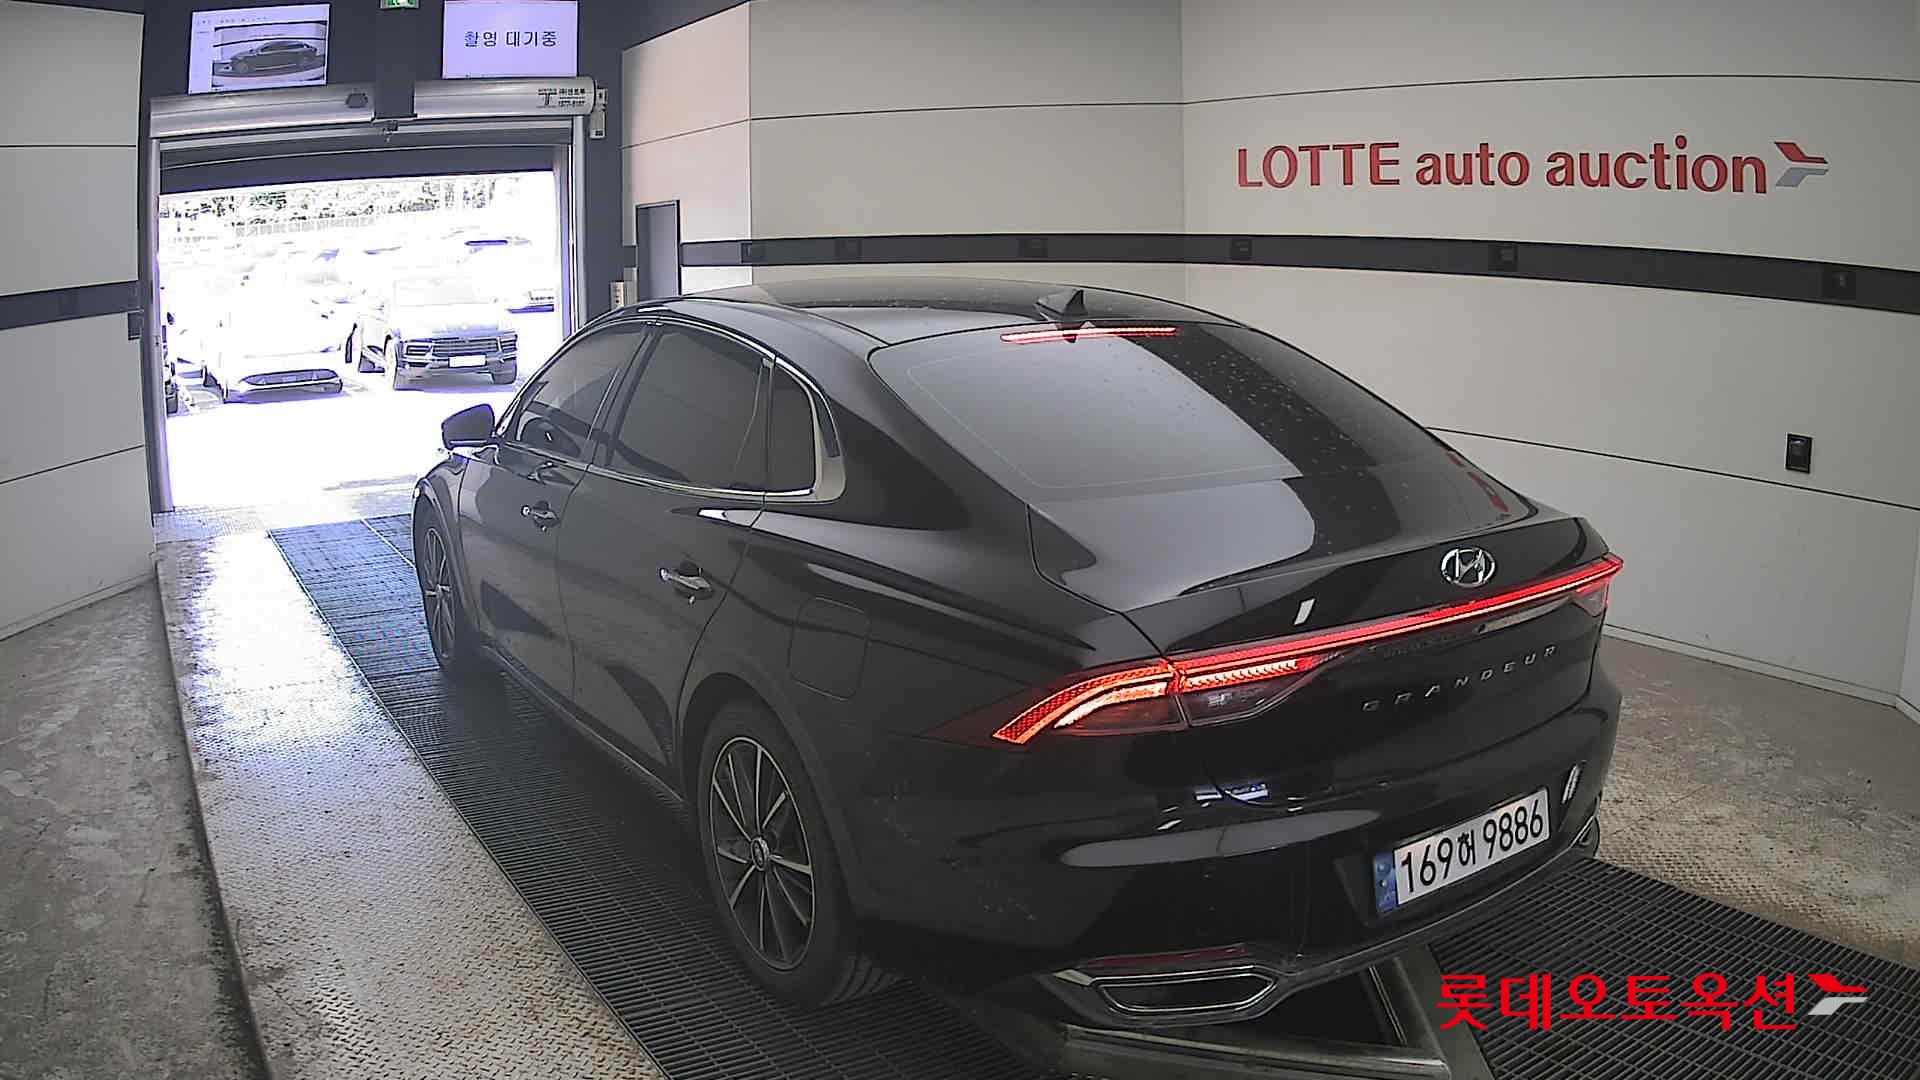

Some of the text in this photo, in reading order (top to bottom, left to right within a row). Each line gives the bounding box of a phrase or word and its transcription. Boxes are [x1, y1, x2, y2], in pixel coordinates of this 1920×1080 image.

[464, 31, 558, 47] 촬영 대기중
[1237, 134, 1768, 194] LOTTE auto auction
[1361, 644, 1556, 713] GRANDEUR
